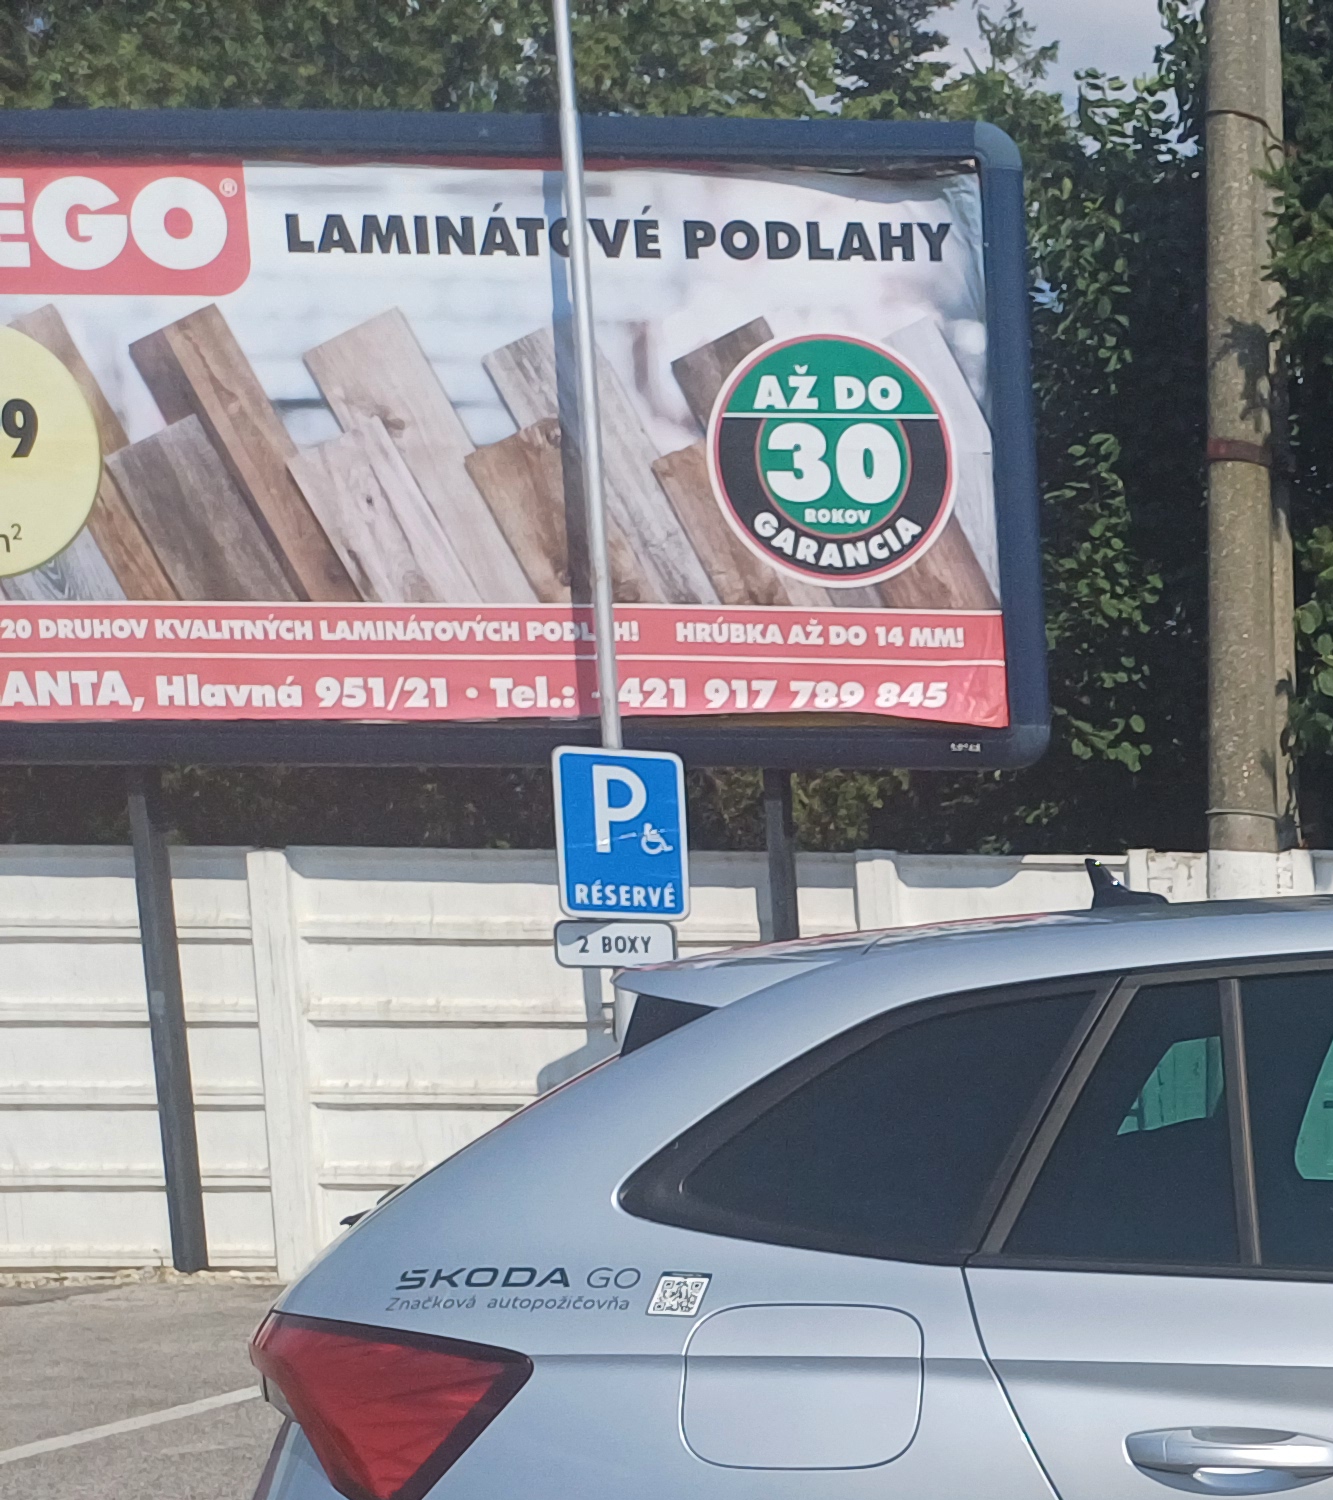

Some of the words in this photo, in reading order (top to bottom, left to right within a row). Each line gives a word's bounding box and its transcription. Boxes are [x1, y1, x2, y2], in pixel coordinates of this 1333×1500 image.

[683, 220, 952, 263] PODLAHY
[753, 364, 820, 411] AŽ
[833, 374, 903, 411] DO
[1, 398, 39, 459] 9
[766, 422, 902, 504] 30
[804, 508, 871, 525] ROKOV
[753, 511, 922, 568] GARANCIA
[0, 618, 33, 640] 20
[38, 618, 149, 640] DRUHOV
[155, 613, 314, 642] KVALITNÝCH
[320, 614, 520, 642] LAMINÁTOVÝCH
[526, 620, 640, 643] PODLH!
[676, 616, 784, 645] HRÚBKA
[787, 617, 825, 646] AŽ
[829, 625, 868, 647] DO
[875, 626, 904, 647] 14
[908, 627, 965, 649] MM!
[2, 670, 145, 713] ANTA,
[156, 674, 303, 709] Hlavná
[315, 676, 449, 711] 951/21
[489, 675, 576, 709] Tel.:
[703, 679, 778, 709] 917
[789, 680, 865, 709] 789
[874, 680, 949, 709] 845
[592, 763, 648, 854] P
[575, 880, 677, 909] RÉSERVÉ
[578, 935, 590, 954] 2
[602, 935, 653, 954] BOXY
[586, 1266, 642, 1290] GO
[385, 1295, 477, 1312] Značková
[487, 1295, 630, 1313] autopožičovňa
